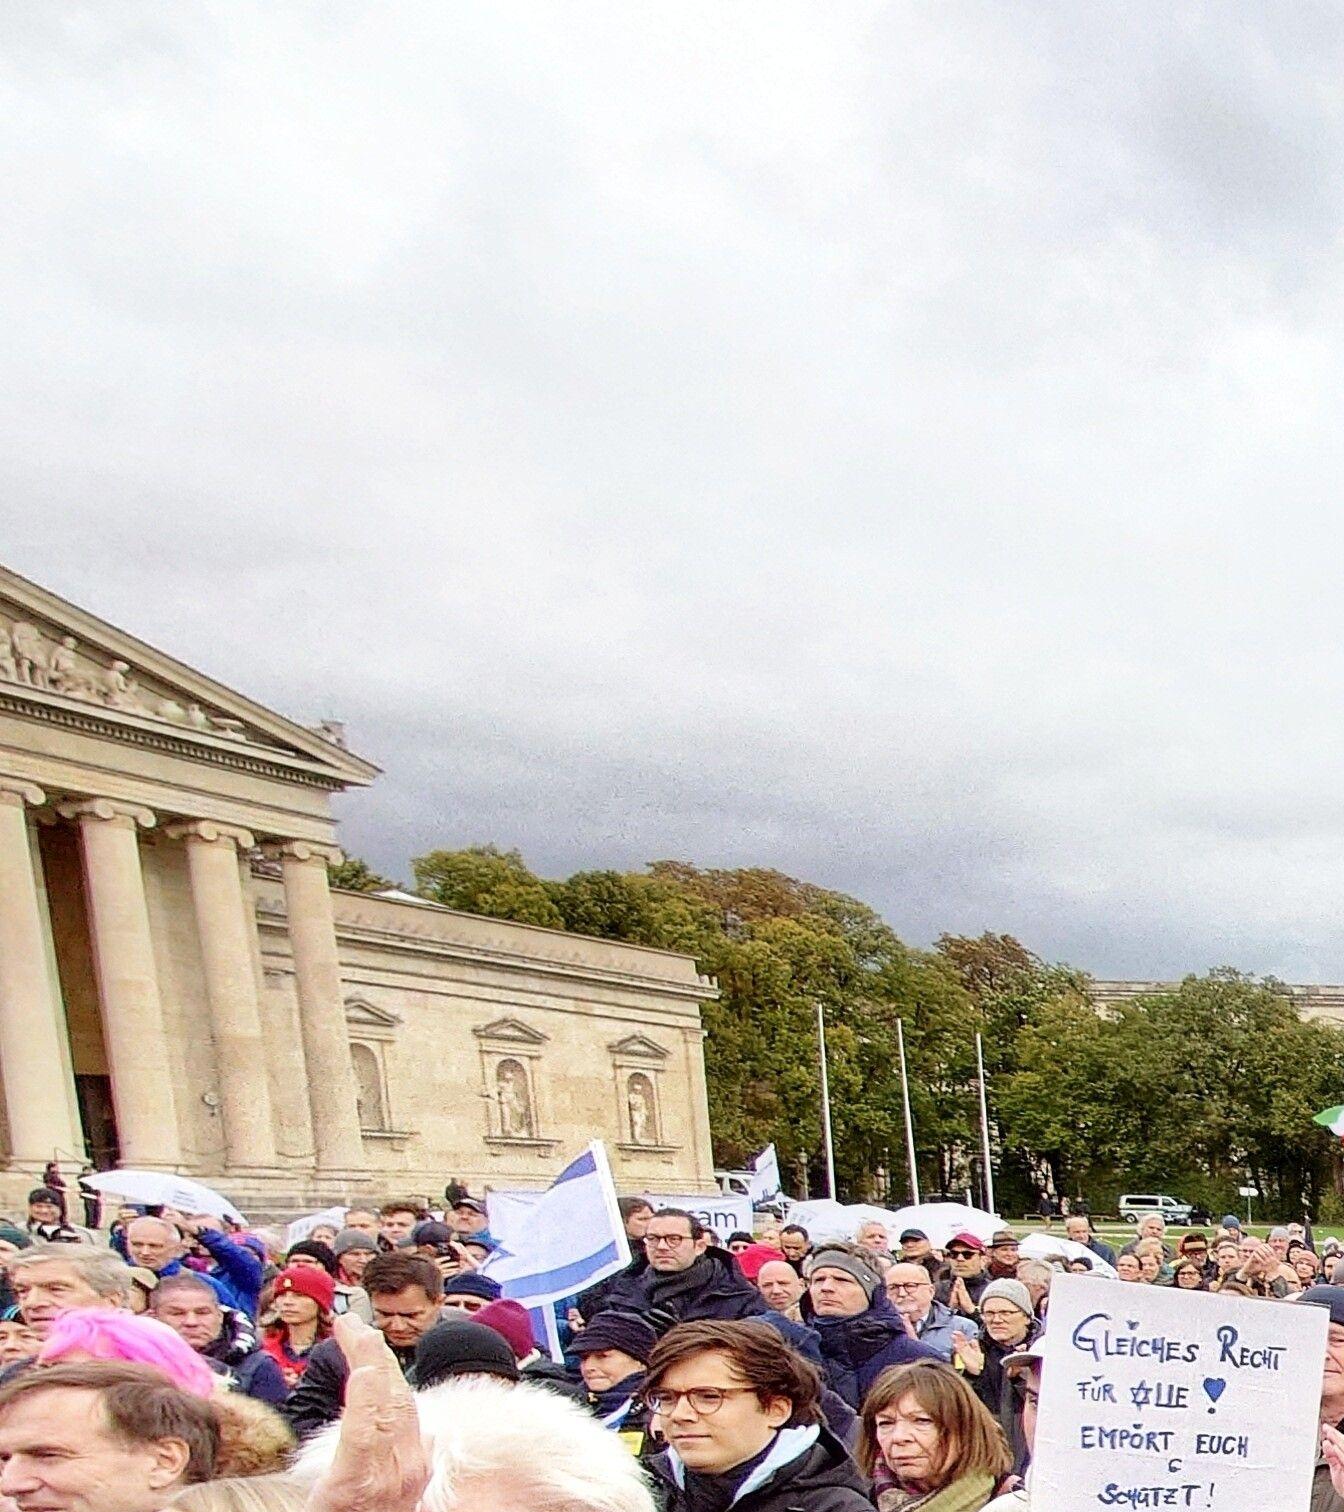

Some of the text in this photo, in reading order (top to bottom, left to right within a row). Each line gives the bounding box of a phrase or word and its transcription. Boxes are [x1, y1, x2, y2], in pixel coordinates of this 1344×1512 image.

[1072, 1313, 1287, 1371] GLEICHES RECHT
[1076, 1374, 1117, 1404] FÜR
[1080, 1423, 1250, 1458] EMPÖRT EUCH
